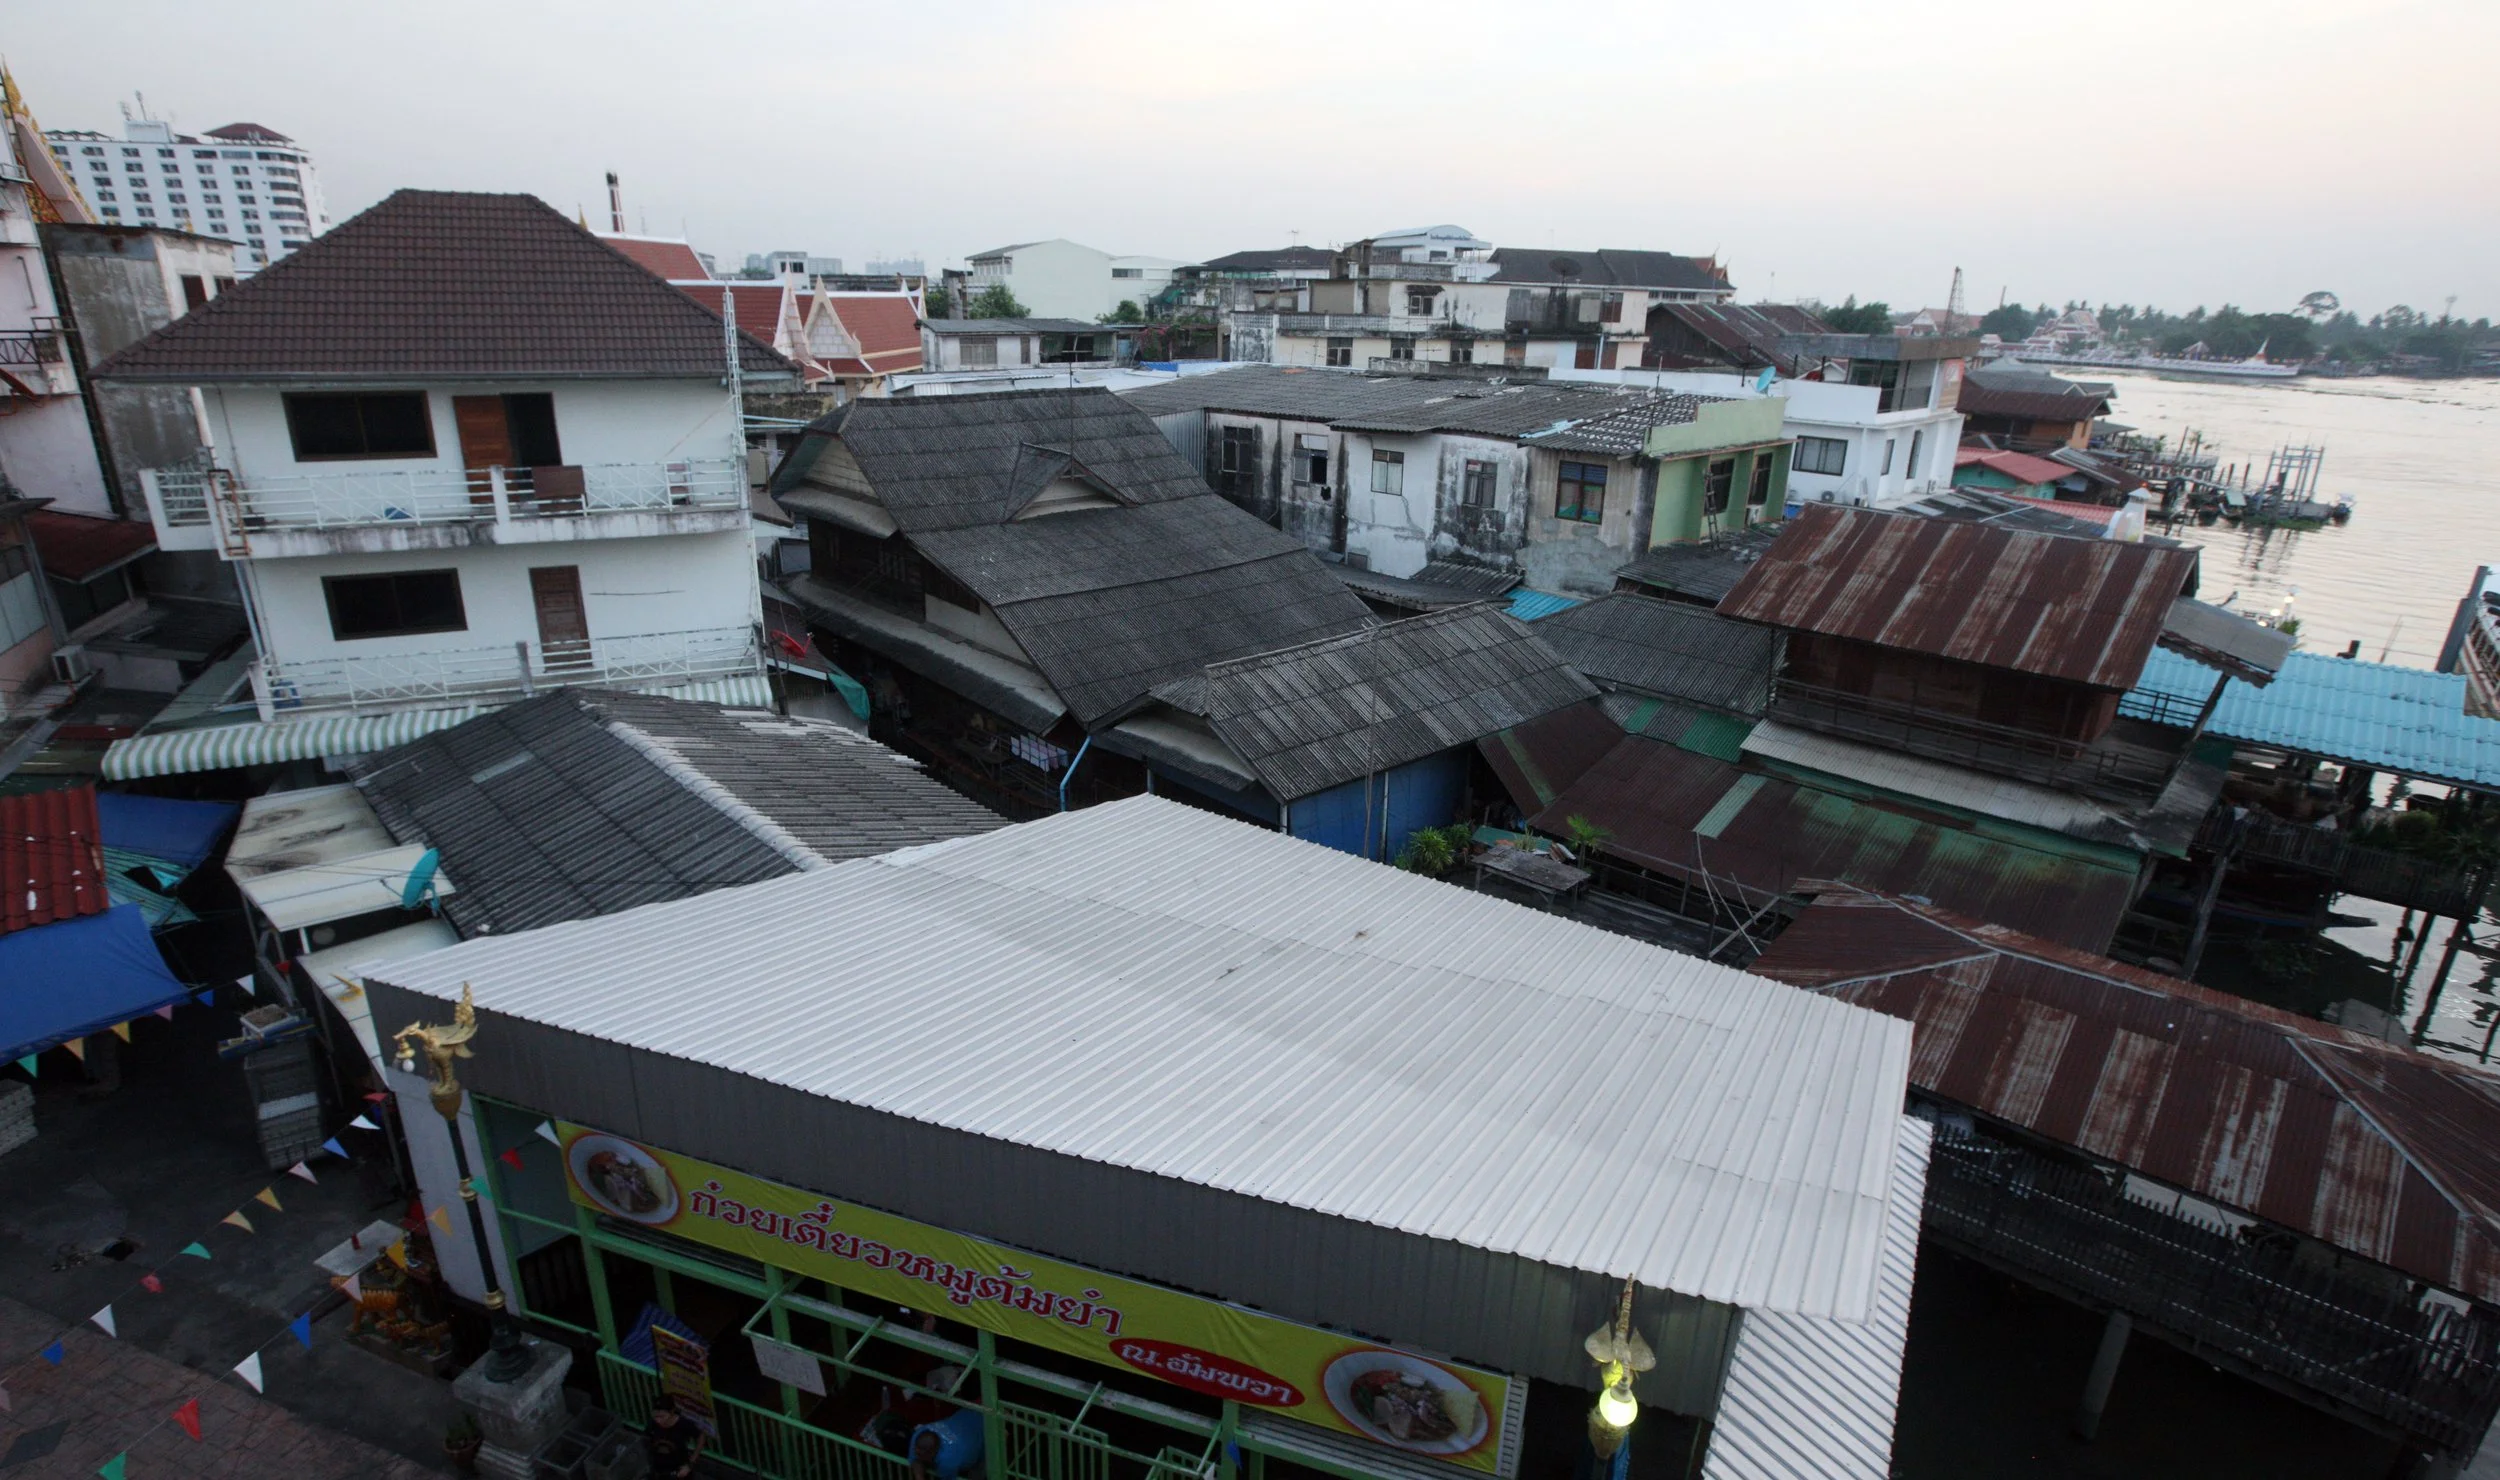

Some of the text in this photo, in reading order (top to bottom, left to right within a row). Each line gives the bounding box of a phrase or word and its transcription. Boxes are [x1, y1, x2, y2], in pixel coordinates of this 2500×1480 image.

[689, 1181, 1124, 1335] ก๋วยเตี๋ยวหมูต้มยำ
